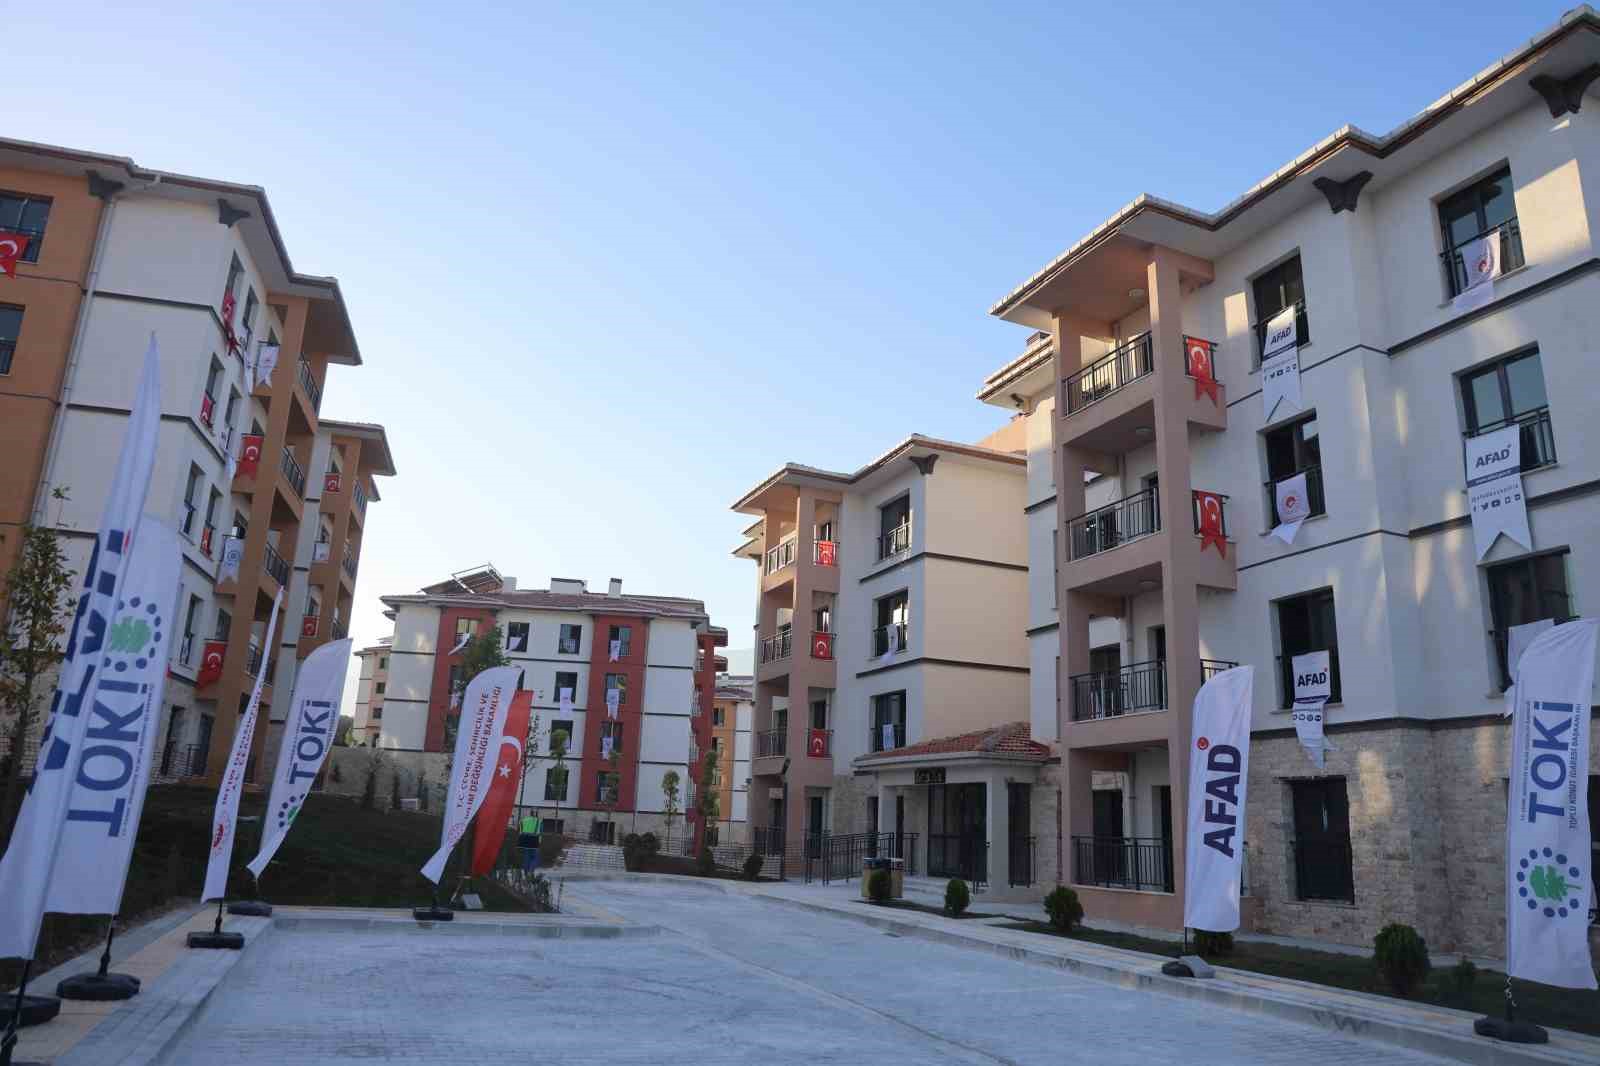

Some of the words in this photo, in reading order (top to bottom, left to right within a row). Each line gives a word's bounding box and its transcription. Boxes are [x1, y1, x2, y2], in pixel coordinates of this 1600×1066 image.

[1270, 326, 1292, 345] AFAD
[1475, 448, 1511, 468] AFAD
[1297, 672, 1327, 688] AFAD
[288, 700, 331, 785] TOKİ
[1528, 701, 1574, 824] TOKİ
[1203, 744, 1242, 859] AFAD
